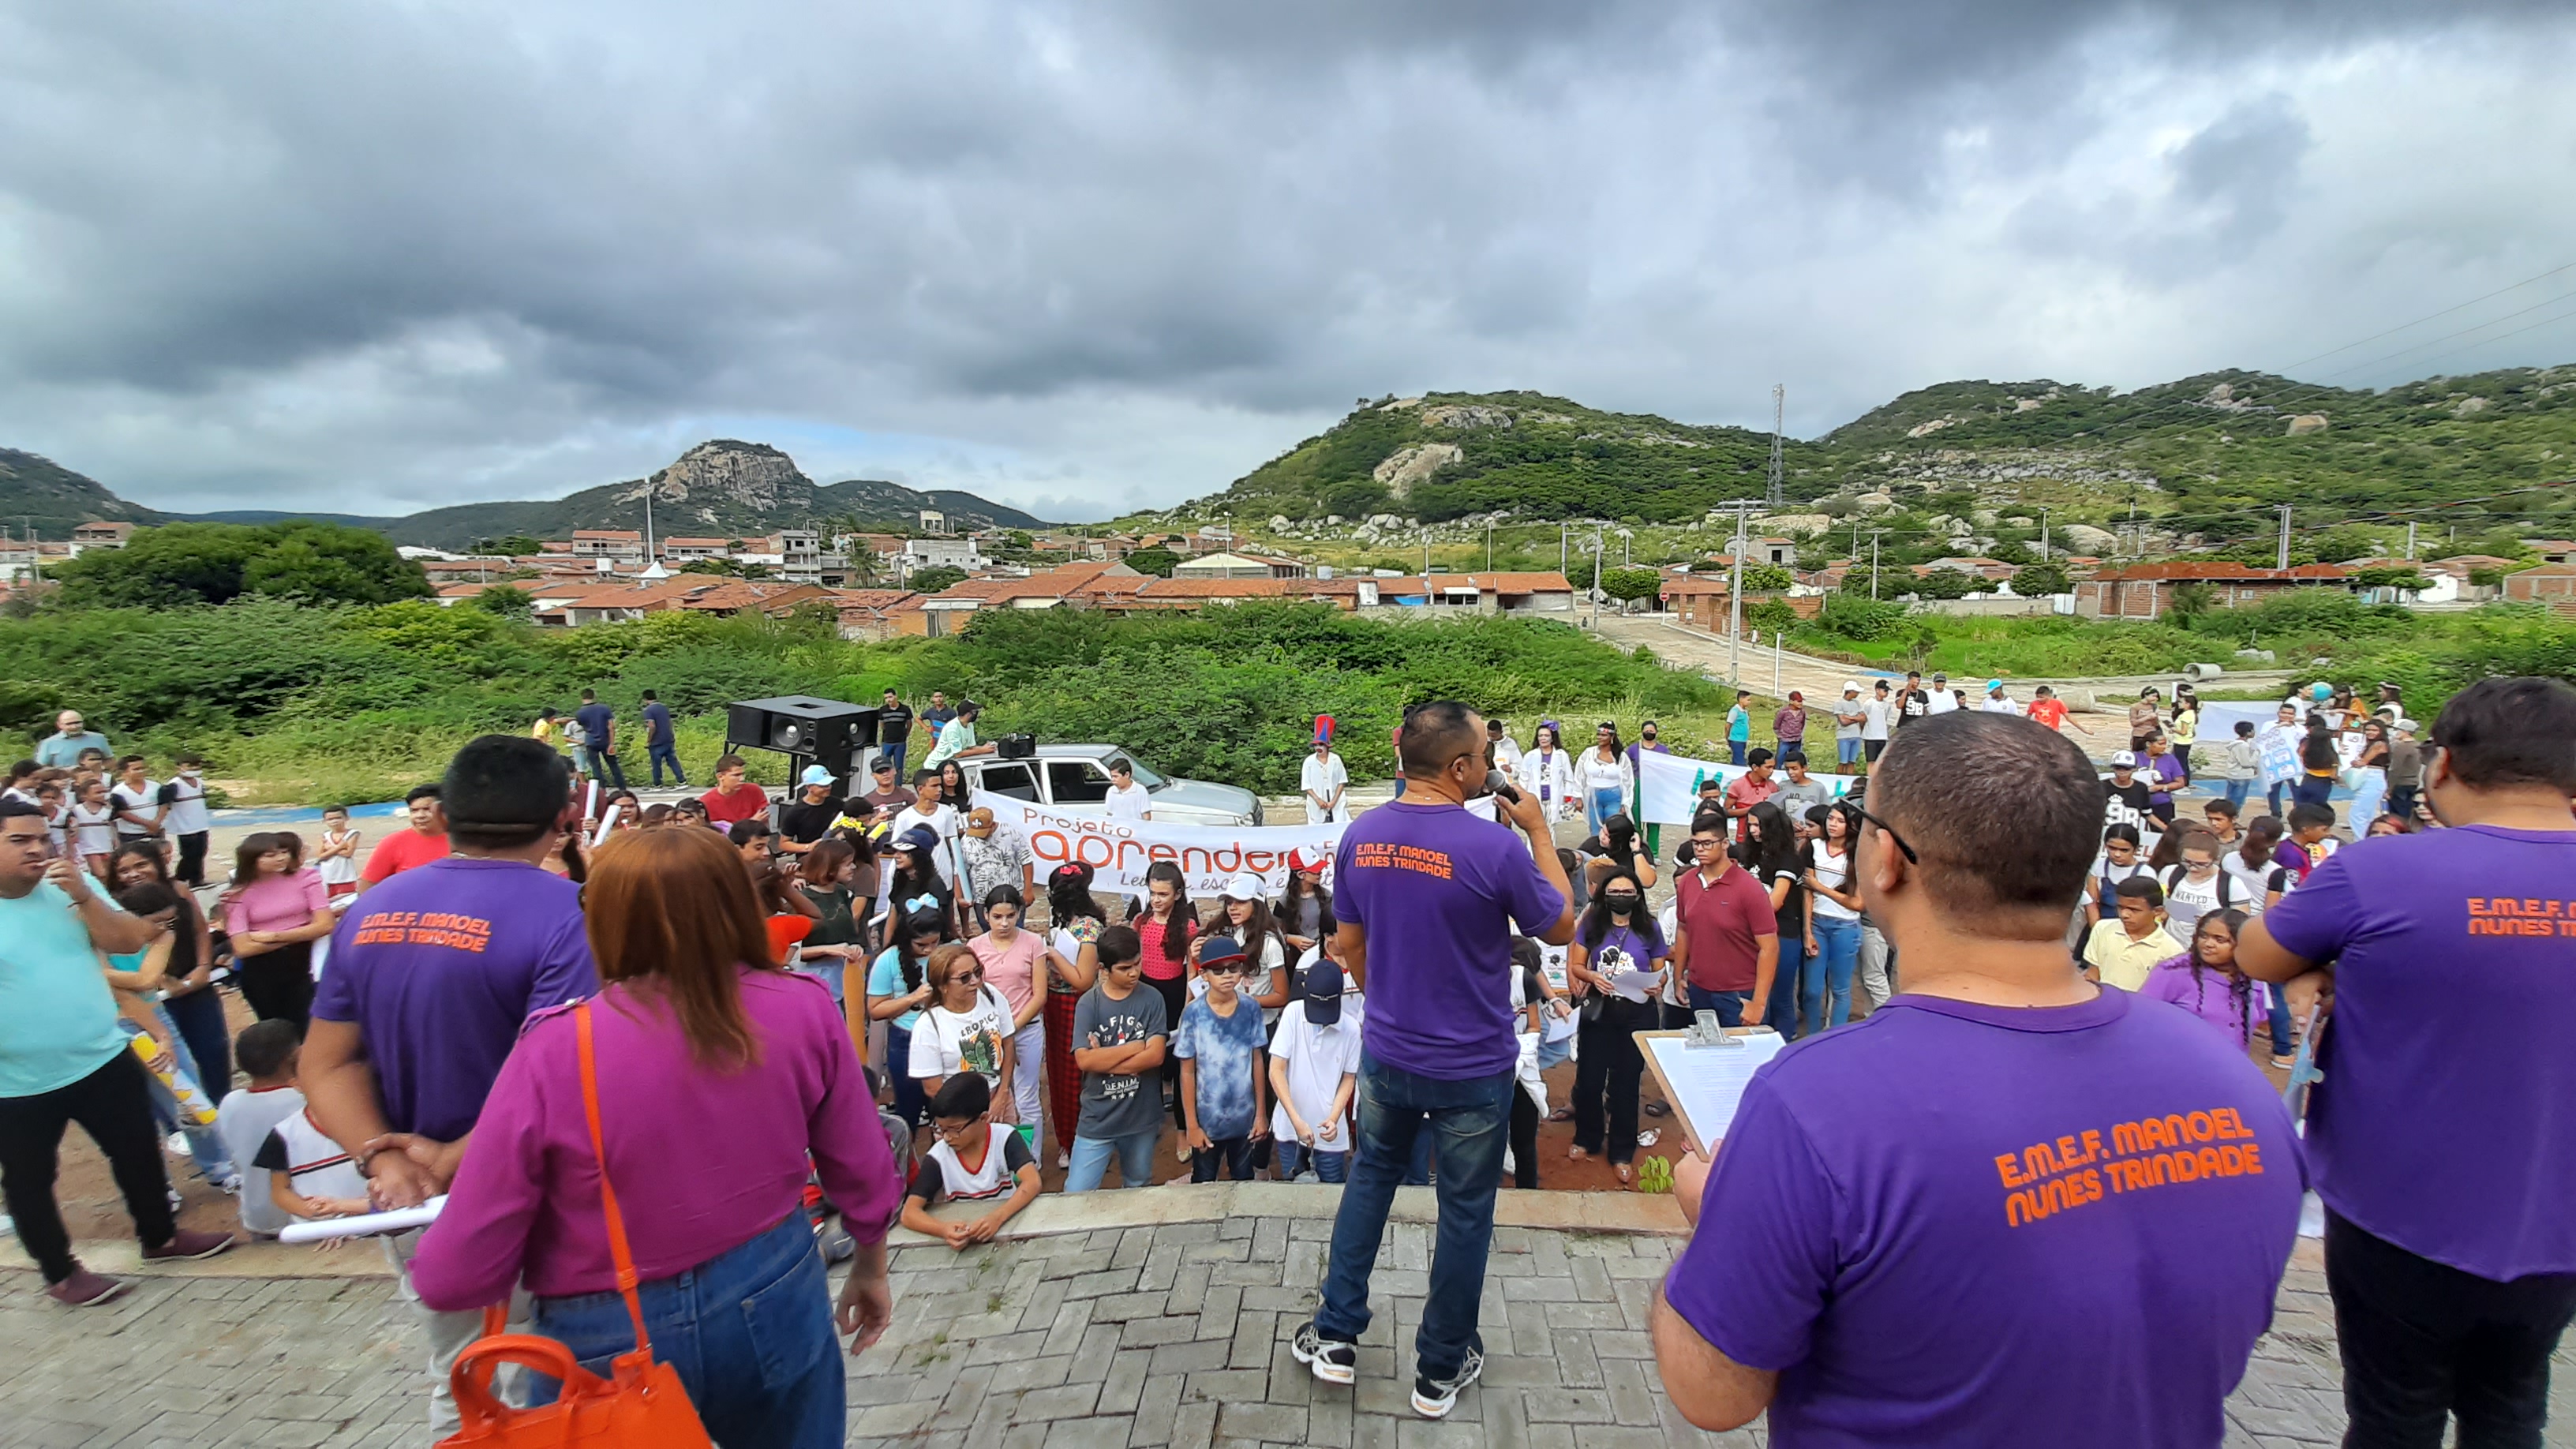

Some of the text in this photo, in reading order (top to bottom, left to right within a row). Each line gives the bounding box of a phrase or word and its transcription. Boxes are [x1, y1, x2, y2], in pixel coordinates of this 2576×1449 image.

[1023, 807, 1133, 838] Projeto
[1356, 843, 1397, 856] E.M.E.F.
[1399, 845, 1453, 867] MANOEL
[1354, 856, 1453, 880] NUNES TRINDADE
[2467, 897, 2564, 918] E.M.E.F.
[418, 912, 491, 937] MANOEL
[2468, 918, 2554, 936] NUNES
[1994, 1107, 2255, 1189] E.M.E.F. MANOEL
[2005, 1144, 2264, 1227] NUNES TRINDADE
